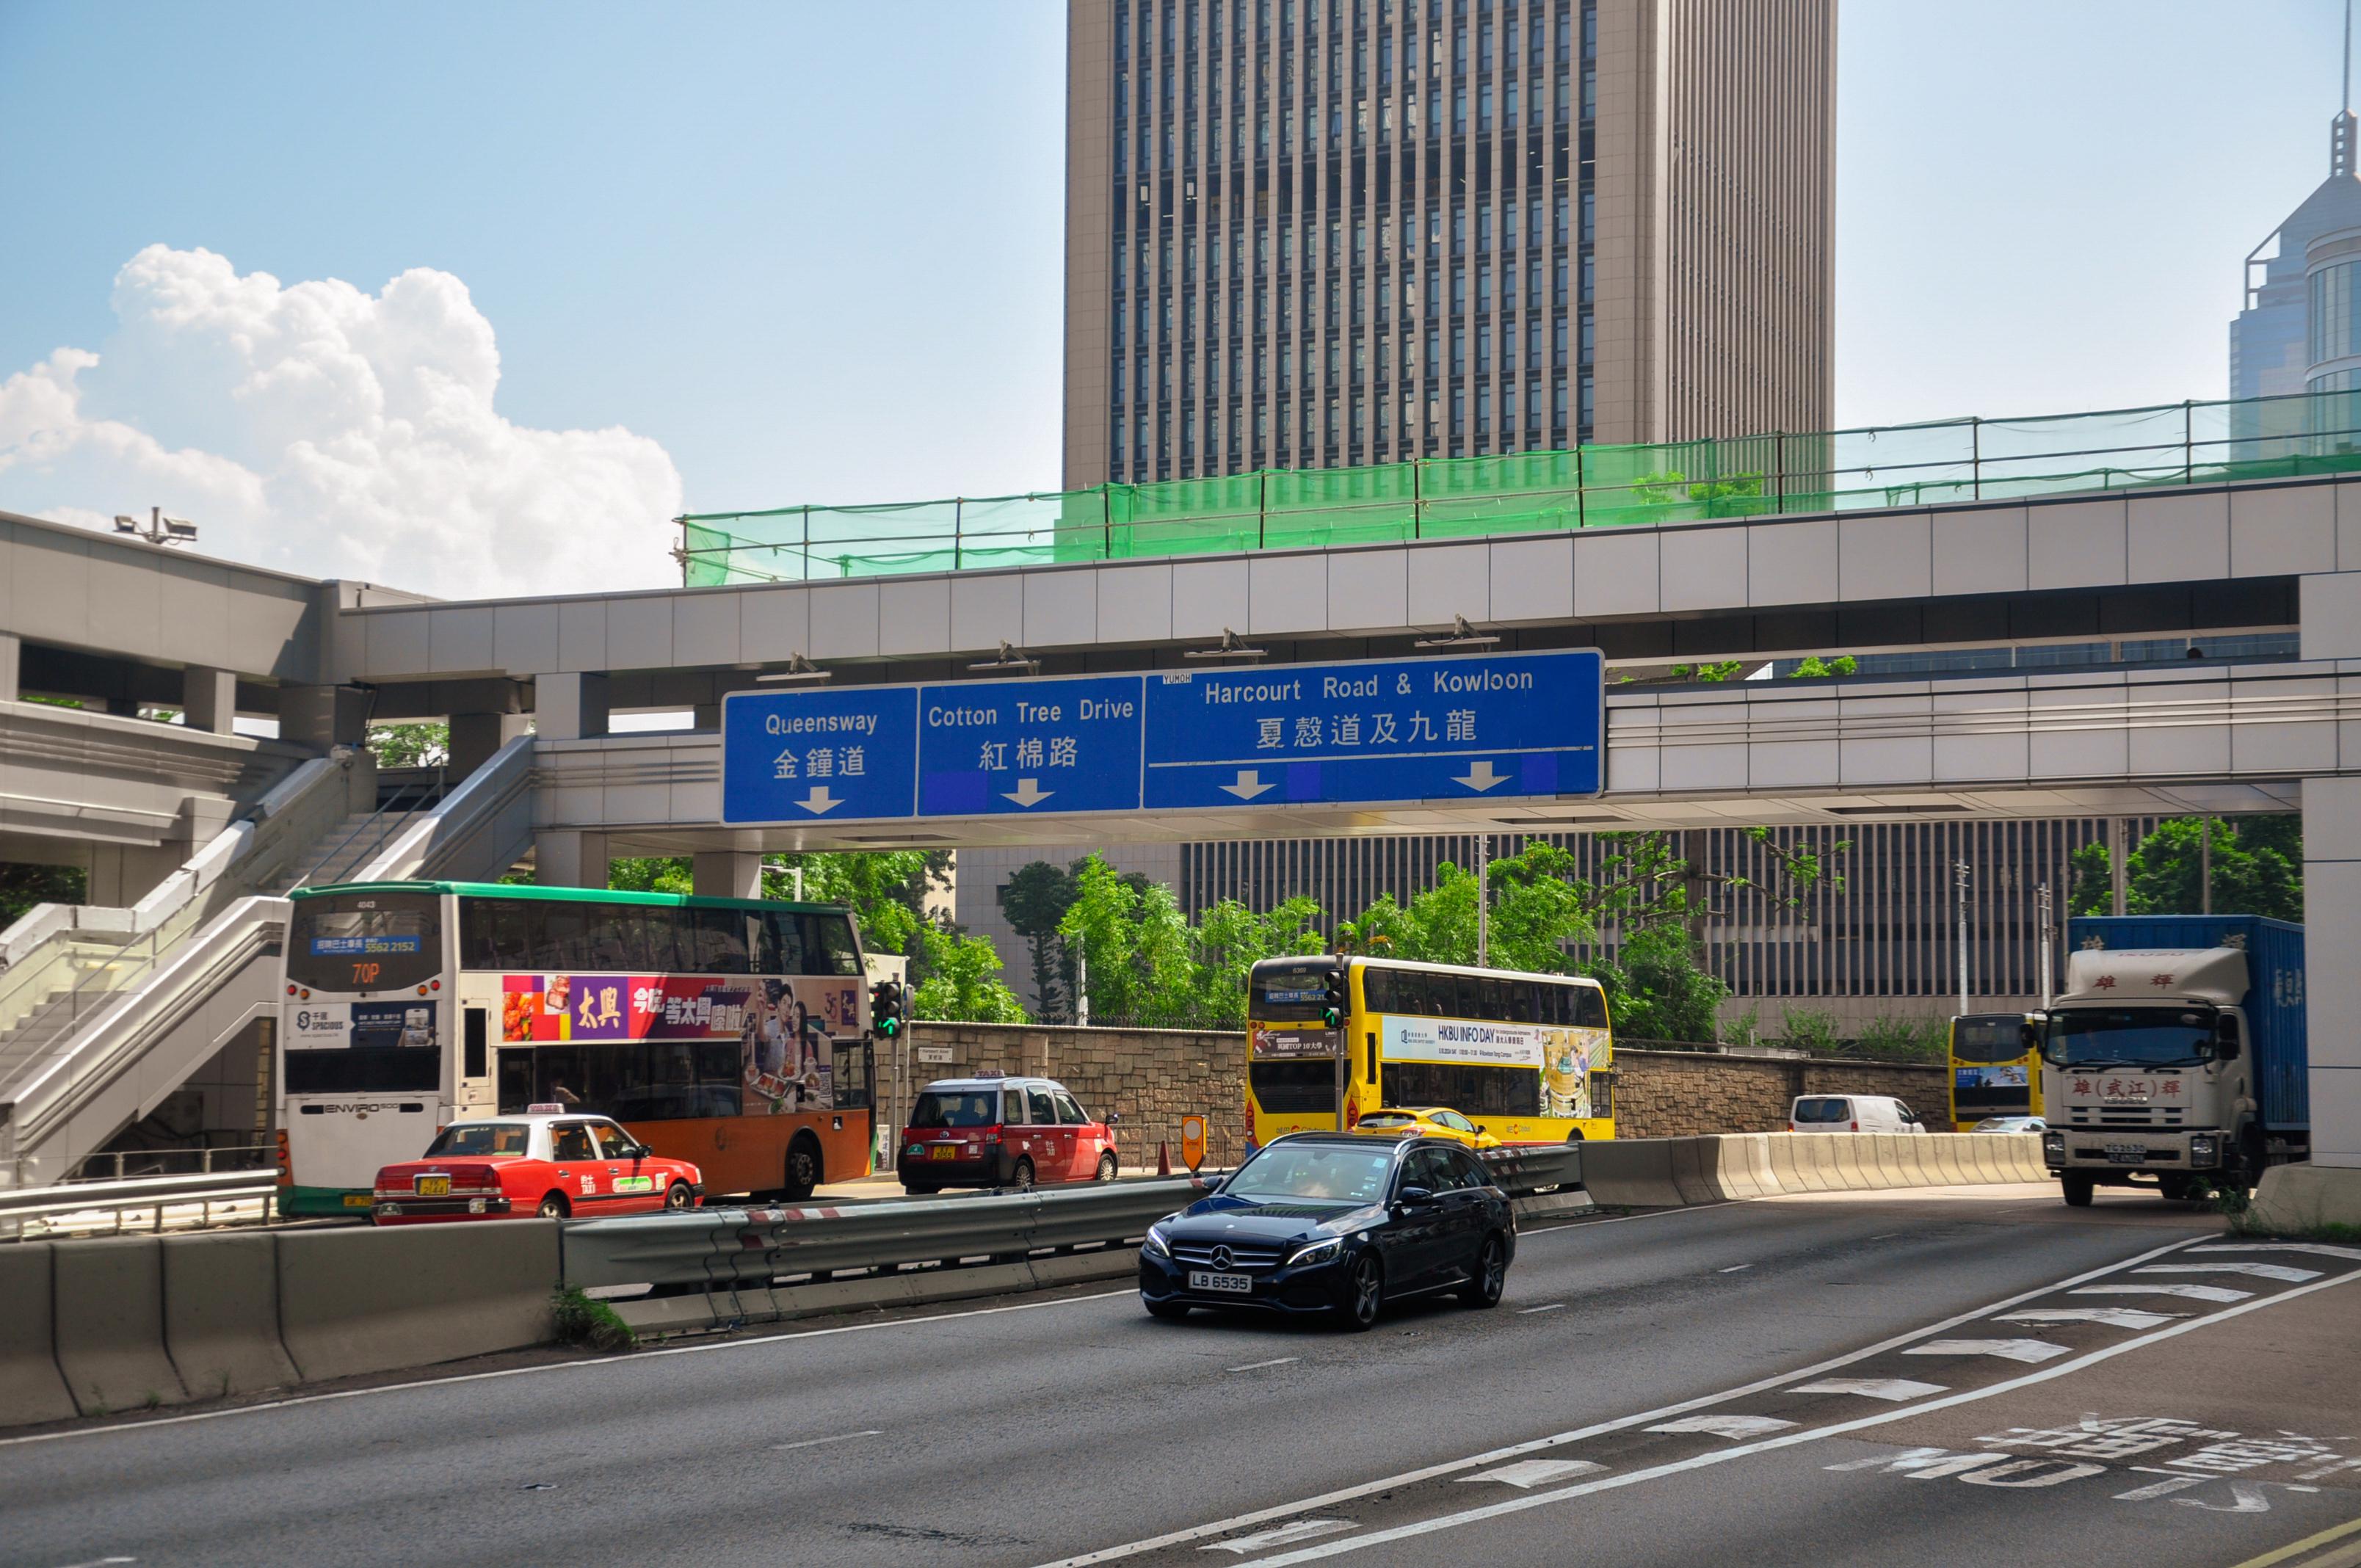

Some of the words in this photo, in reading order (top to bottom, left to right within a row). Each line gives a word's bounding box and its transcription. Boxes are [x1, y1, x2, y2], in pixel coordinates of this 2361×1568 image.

[1164, 674, 1191, 683] YUMOH
[1205, 680, 1301, 705] Harcourt
[1324, 674, 1378, 698] Road
[1396, 672, 1412, 694] &
[1434, 669, 1533, 693] Kowloon
[929, 705, 997, 727] Cotton
[1017, 701, 1062, 723] Tree
[1080, 697, 1134, 720] Drive
[766, 714, 877, 736] Queensway
[979, 736, 1078, 771] 紅棉路
[357, 901, 377, 909] 4043
[365, 943, 388, 952] 5562
[391, 942, 416, 951] 2152
[352, 962, 380, 984] 70P
[2092, 976, 2118, 991] 雄
[2150, 973, 2175, 990] 輝
[578, 986, 622, 1029] 太興
[312, 1021, 344, 1030] SPACIOUS
[1438, 1025, 1459, 1042] HKBU
[1460, 1026, 1478, 1043] INFO
[1479, 1028, 1495, 1044] DAY
[581, 1184, 597, 1194] TAXI
[1192, 1274, 1209, 1287] LB
[1212, 1276, 1249, 1290] 6535
